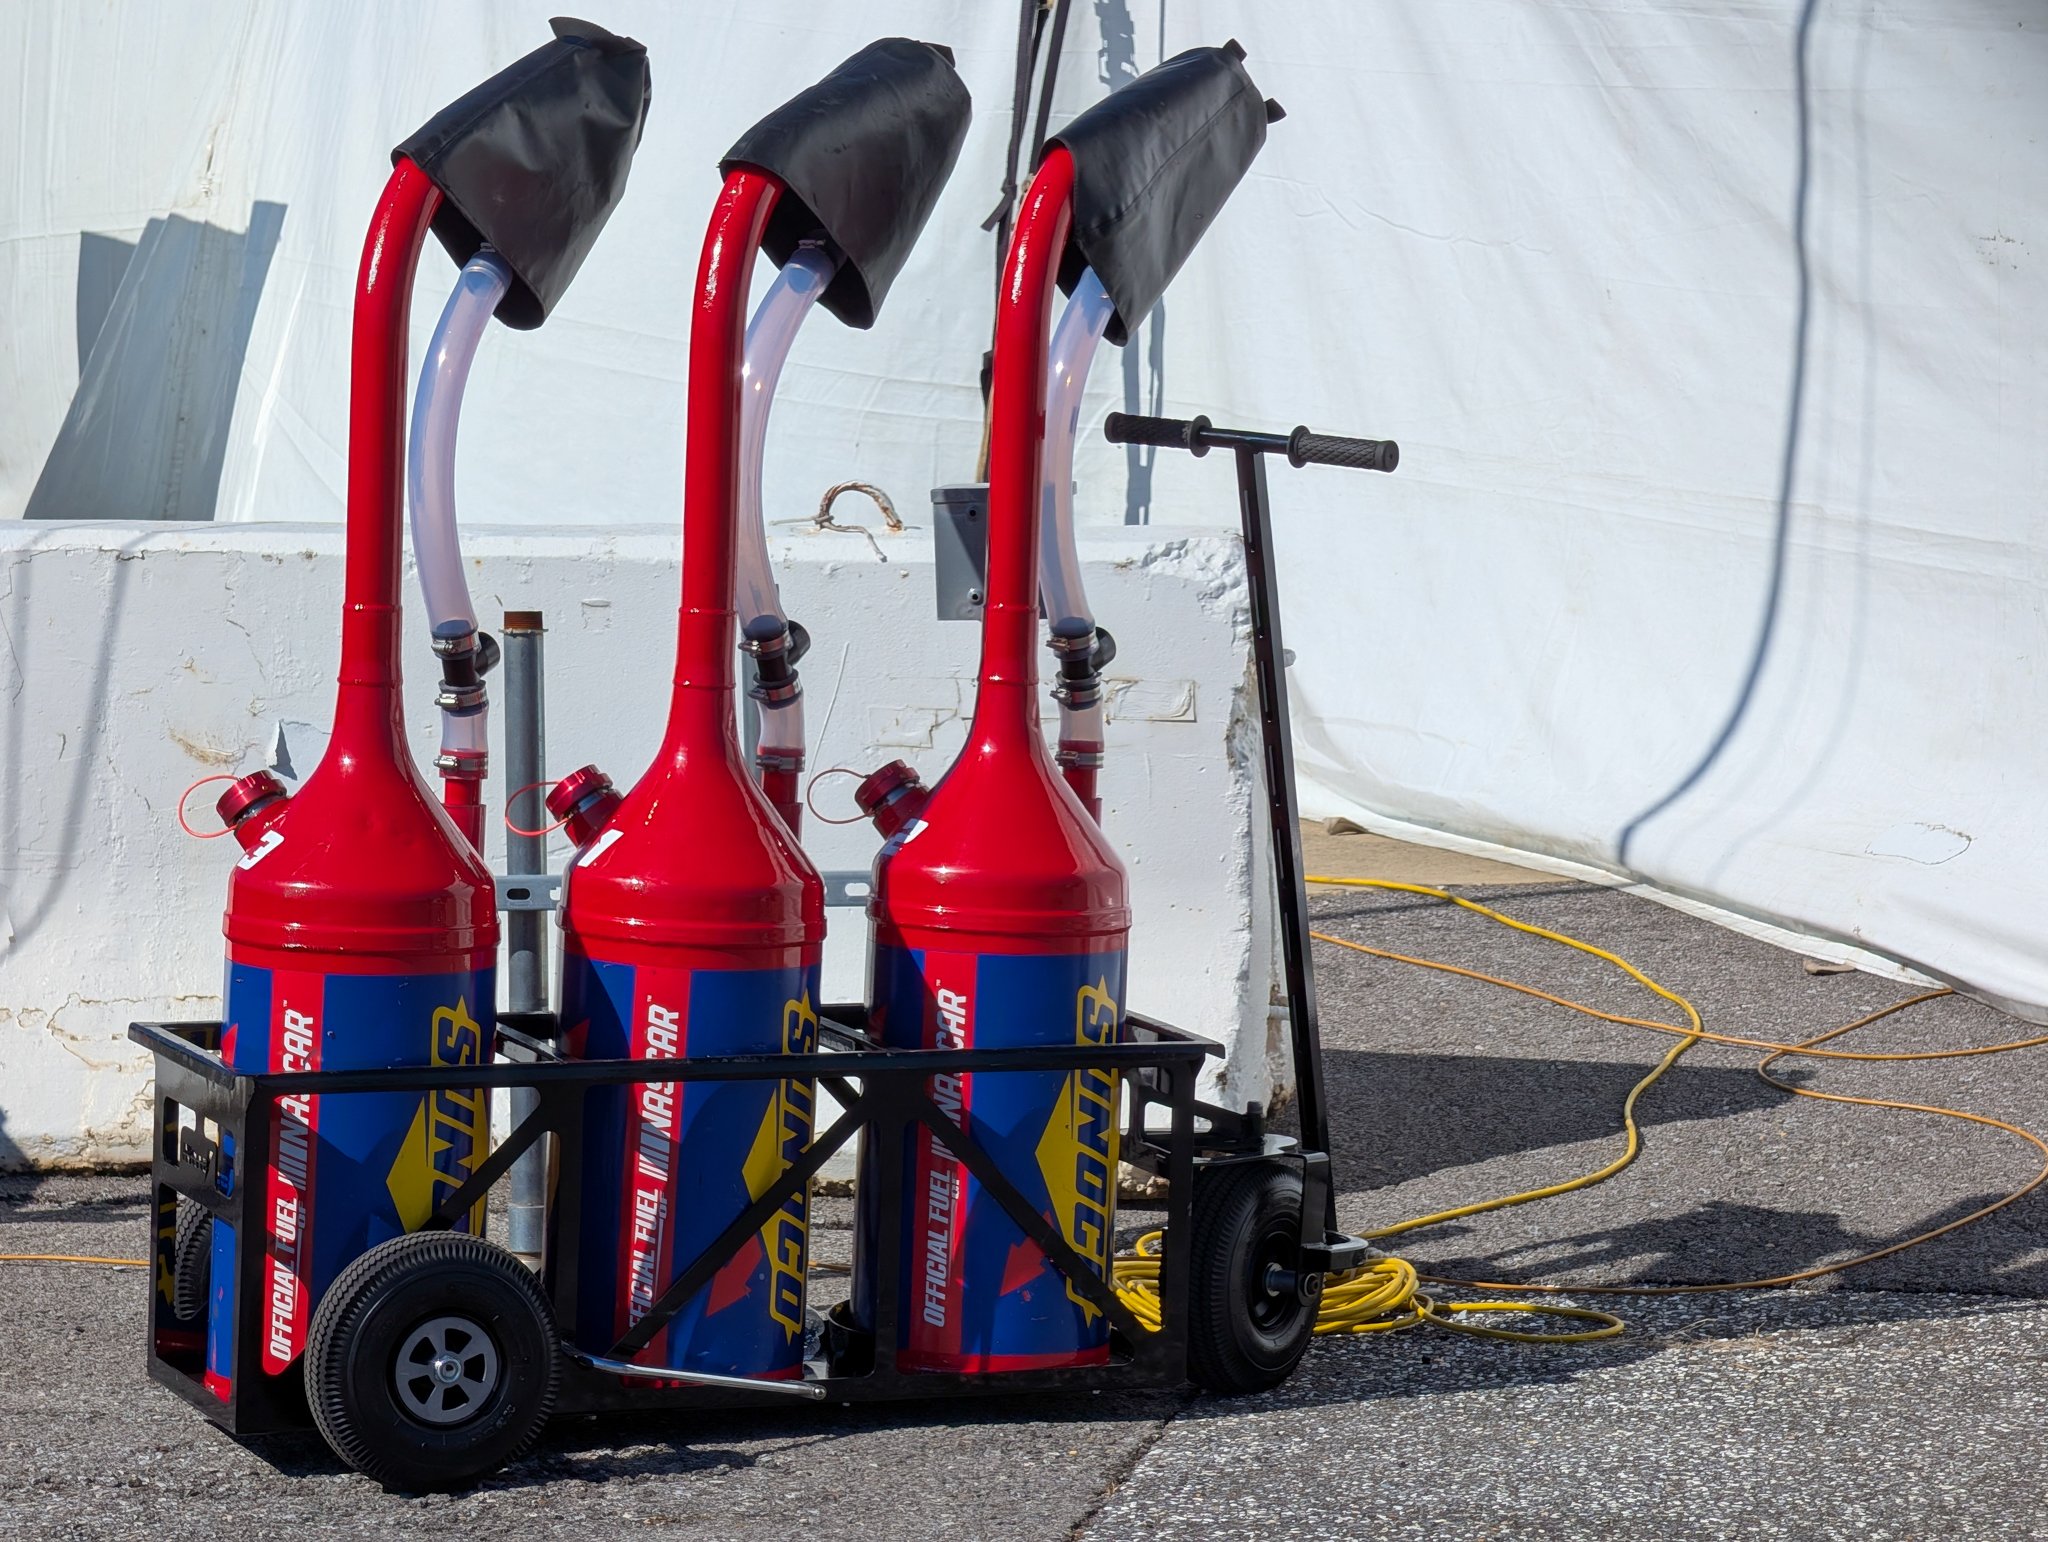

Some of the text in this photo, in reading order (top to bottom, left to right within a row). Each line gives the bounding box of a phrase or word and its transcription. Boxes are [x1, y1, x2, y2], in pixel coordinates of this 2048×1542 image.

[236, 829, 286, 871] 3
[278, 1009, 315, 1144] NACAR
[933, 988, 967, 1121] NACAR
[268, 1196, 298, 1361] OFFICIAL FUEL
[629, 1188, 659, 1349] FICIAL FUEL
[923, 1169, 951, 1328] OFFICIAL FUEL
